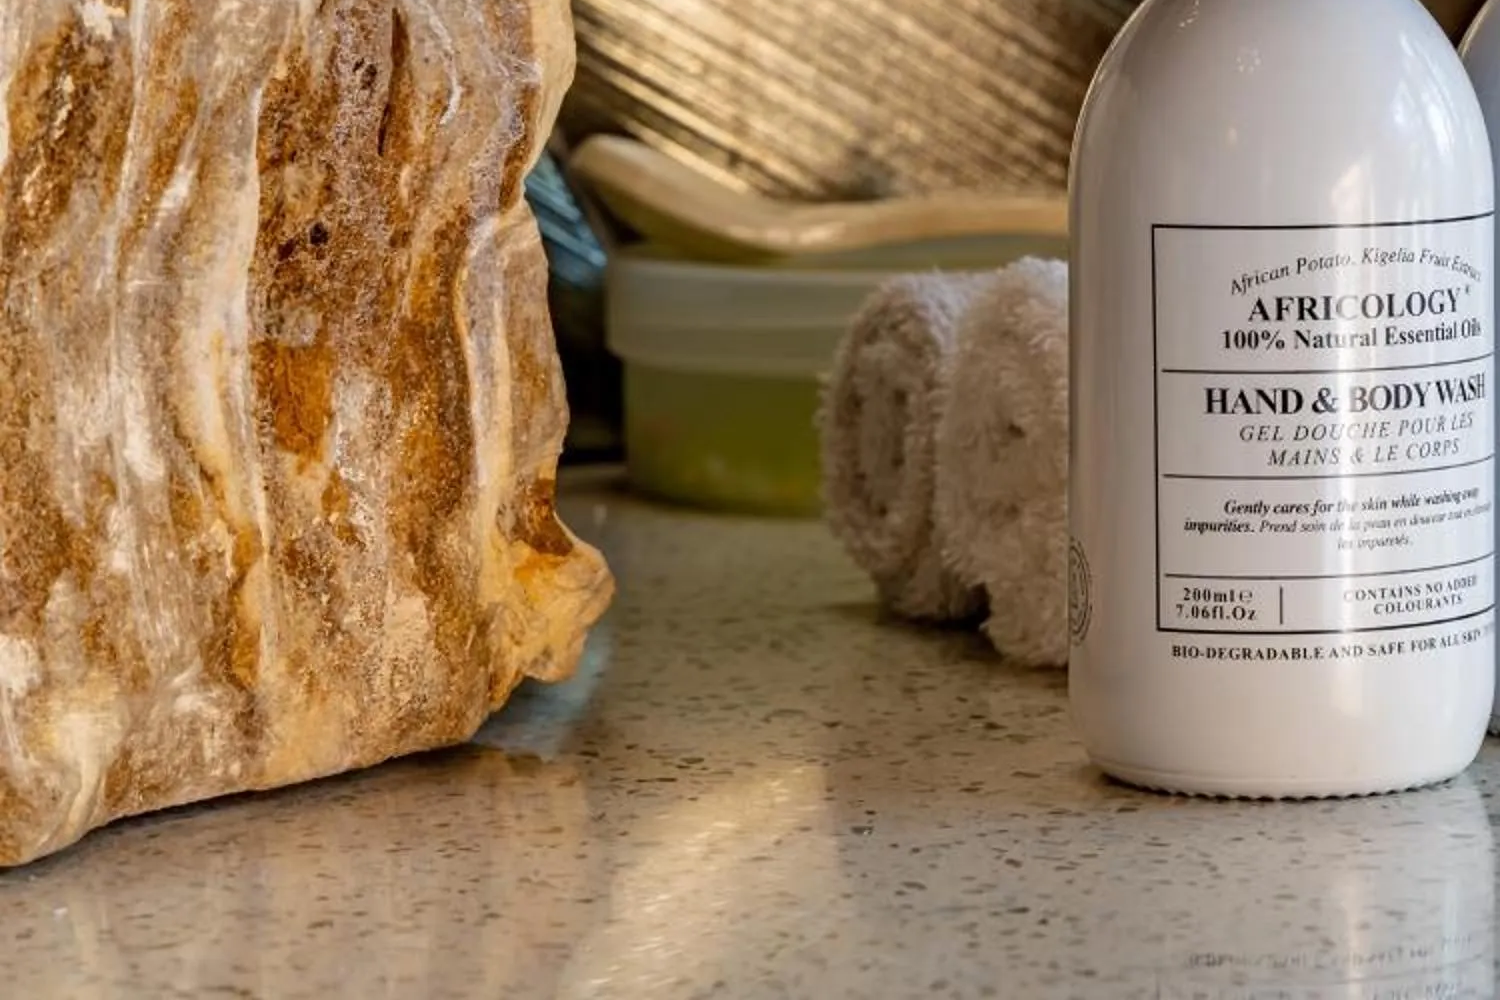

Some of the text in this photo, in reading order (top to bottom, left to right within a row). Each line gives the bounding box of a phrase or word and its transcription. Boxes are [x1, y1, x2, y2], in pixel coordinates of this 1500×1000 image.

[1231, 265, 1290, 296] African
[1362, 247, 1415, 265] Kigelia
[1222, 329, 1286, 350] 100%
[1294, 326, 1377, 349] Natural
[1385, 321, 1457, 345] Essential
[1205, 373, 1486, 415] HAND & BODY WASH
[1239, 424, 1287, 442] GEL
[1293, 419, 1391, 442] DOUCHE
[1399, 414, 1449, 438] POUR
[1266, 437, 1461, 467] MAINS & LE CORPS
[1223, 499, 1272, 517] Gently
[1273, 500, 1309, 515] cares
[1311, 497, 1334, 517] for
[1361, 496, 1388, 512] skin
[1391, 492, 1421, 509] while
[1258, 519, 1298, 534] Prend
[1299, 519, 1326, 534] soin
[1343, 582, 1421, 601] CONTAINS
[1425, 581, 1444, 595] NO
[1373, 593, 1463, 616] COLOURANTS
[1171, 643, 1325, 662] BIO-DEGRADABLE
[1328, 644, 1364, 660] AND
[1370, 639, 1406, 657] SAFE
[1410, 636, 1437, 654] FOR
